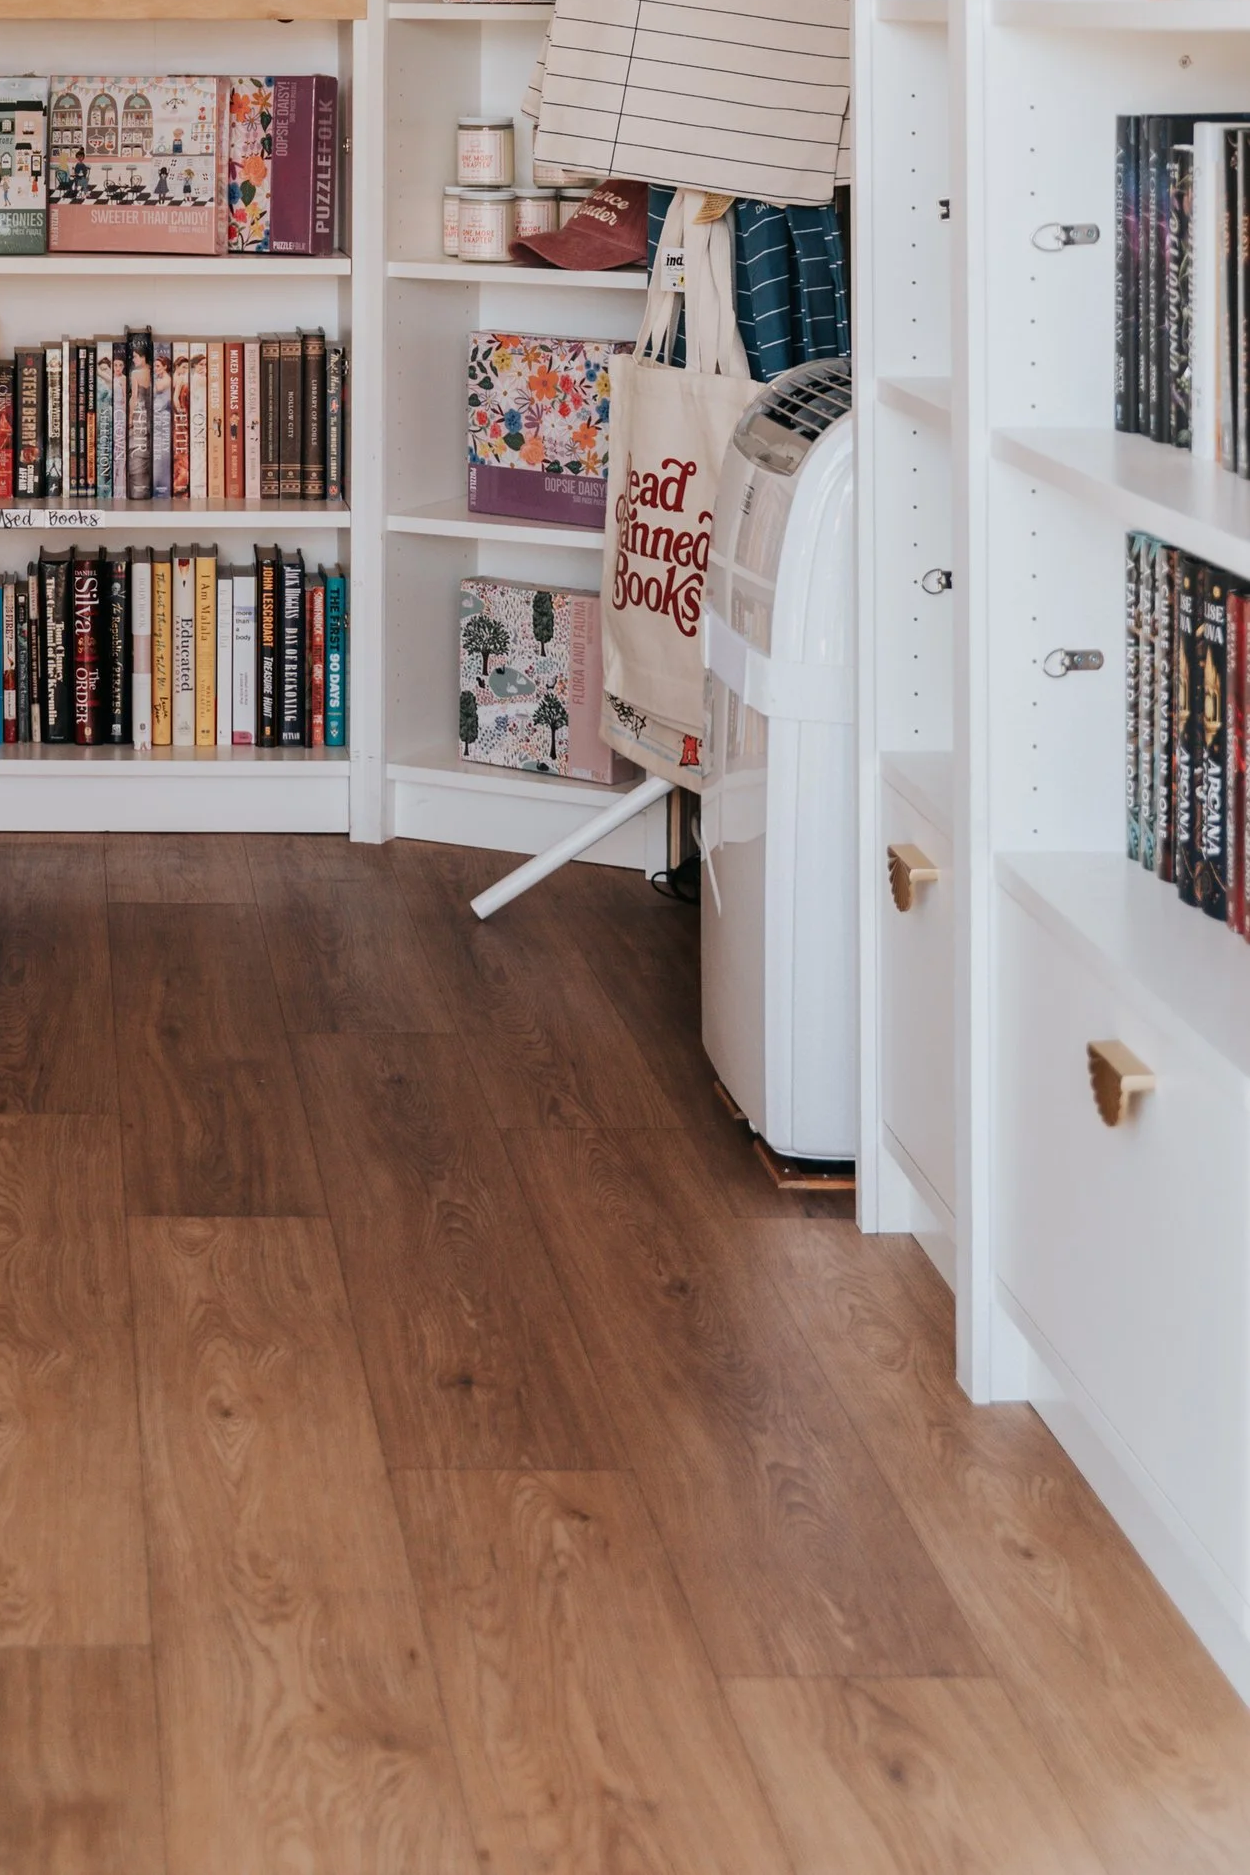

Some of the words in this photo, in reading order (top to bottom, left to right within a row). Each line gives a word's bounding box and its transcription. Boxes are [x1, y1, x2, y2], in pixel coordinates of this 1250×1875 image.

[277, 81, 290, 116] DAISY!
[276, 118, 288, 157] OOPSIE
[315, 100, 333, 233] PUZZLEFOLK
[462, 161, 491, 169] CHAPTER
[0, 213, 43, 226] PEONIES
[91, 210, 138, 224] SWEETER
[142, 211, 167, 224] THAN
[171, 211, 208, 225] CANDY!
[273, 241, 306, 250] PUZZLEFOLK
[230, 349, 238, 374] MIXED
[21, 368, 37, 403] STEVE
[230, 377, 239, 410] SIGNALS
[21, 407, 37, 446] BERRY
[51, 408, 60, 438] WILDER
[192, 413, 205, 446] ONE
[311, 411, 317, 421] OF
[100, 408, 111, 477] SELECTION
[114, 409, 126, 461] CROWN
[132, 410, 147, 458] HEIR
[175, 413, 187, 455] ELITE
[18, 467, 27, 491] AFFAIR
[545, 477, 575, 494] OOPSIE
[49, 510, 100, 526] Books
[200, 583, 211, 601] Am
[263, 566, 274, 590] JOHN
[284, 566, 301, 585] JACK
[75, 577, 100, 635] Silva
[284, 587, 300, 619] HIGGINS
[330, 587, 340, 612] THE
[612, 550, 704, 637] Books
[1126, 581, 1135, 625] FATE
[200, 605, 211, 641] Malala
[263, 593, 274, 647] LESCROART
[330, 615, 340, 651] FIRST
[573, 601, 586, 638] FAUNA
[1159, 583, 1169, 648] CURSE
[285, 627, 298, 645] DAY
[573, 641, 586, 666] AND
[180, 618, 193, 691] Educated
[285, 649, 298, 660] OF
[330, 653, 340, 669] 90
[1126, 636, 1135, 700] INKED
[88, 668, 100, 690] The
[263, 656, 274, 695] TREASURE
[284, 664, 298, 722] RECKONING
[330, 673, 340, 708] DAYS
[572, 670, 585, 705] FLORA
[76, 667, 88, 724] ORDER
[263, 696, 274, 718] HUNT
[1159, 661, 1169, 743] CARVED
[1126, 742, 1135, 808] BLOOD
[1159, 752, 1168, 774] IN
[1158, 785, 1168, 839] BONE
[1208, 757, 1222, 856] ARCANA
